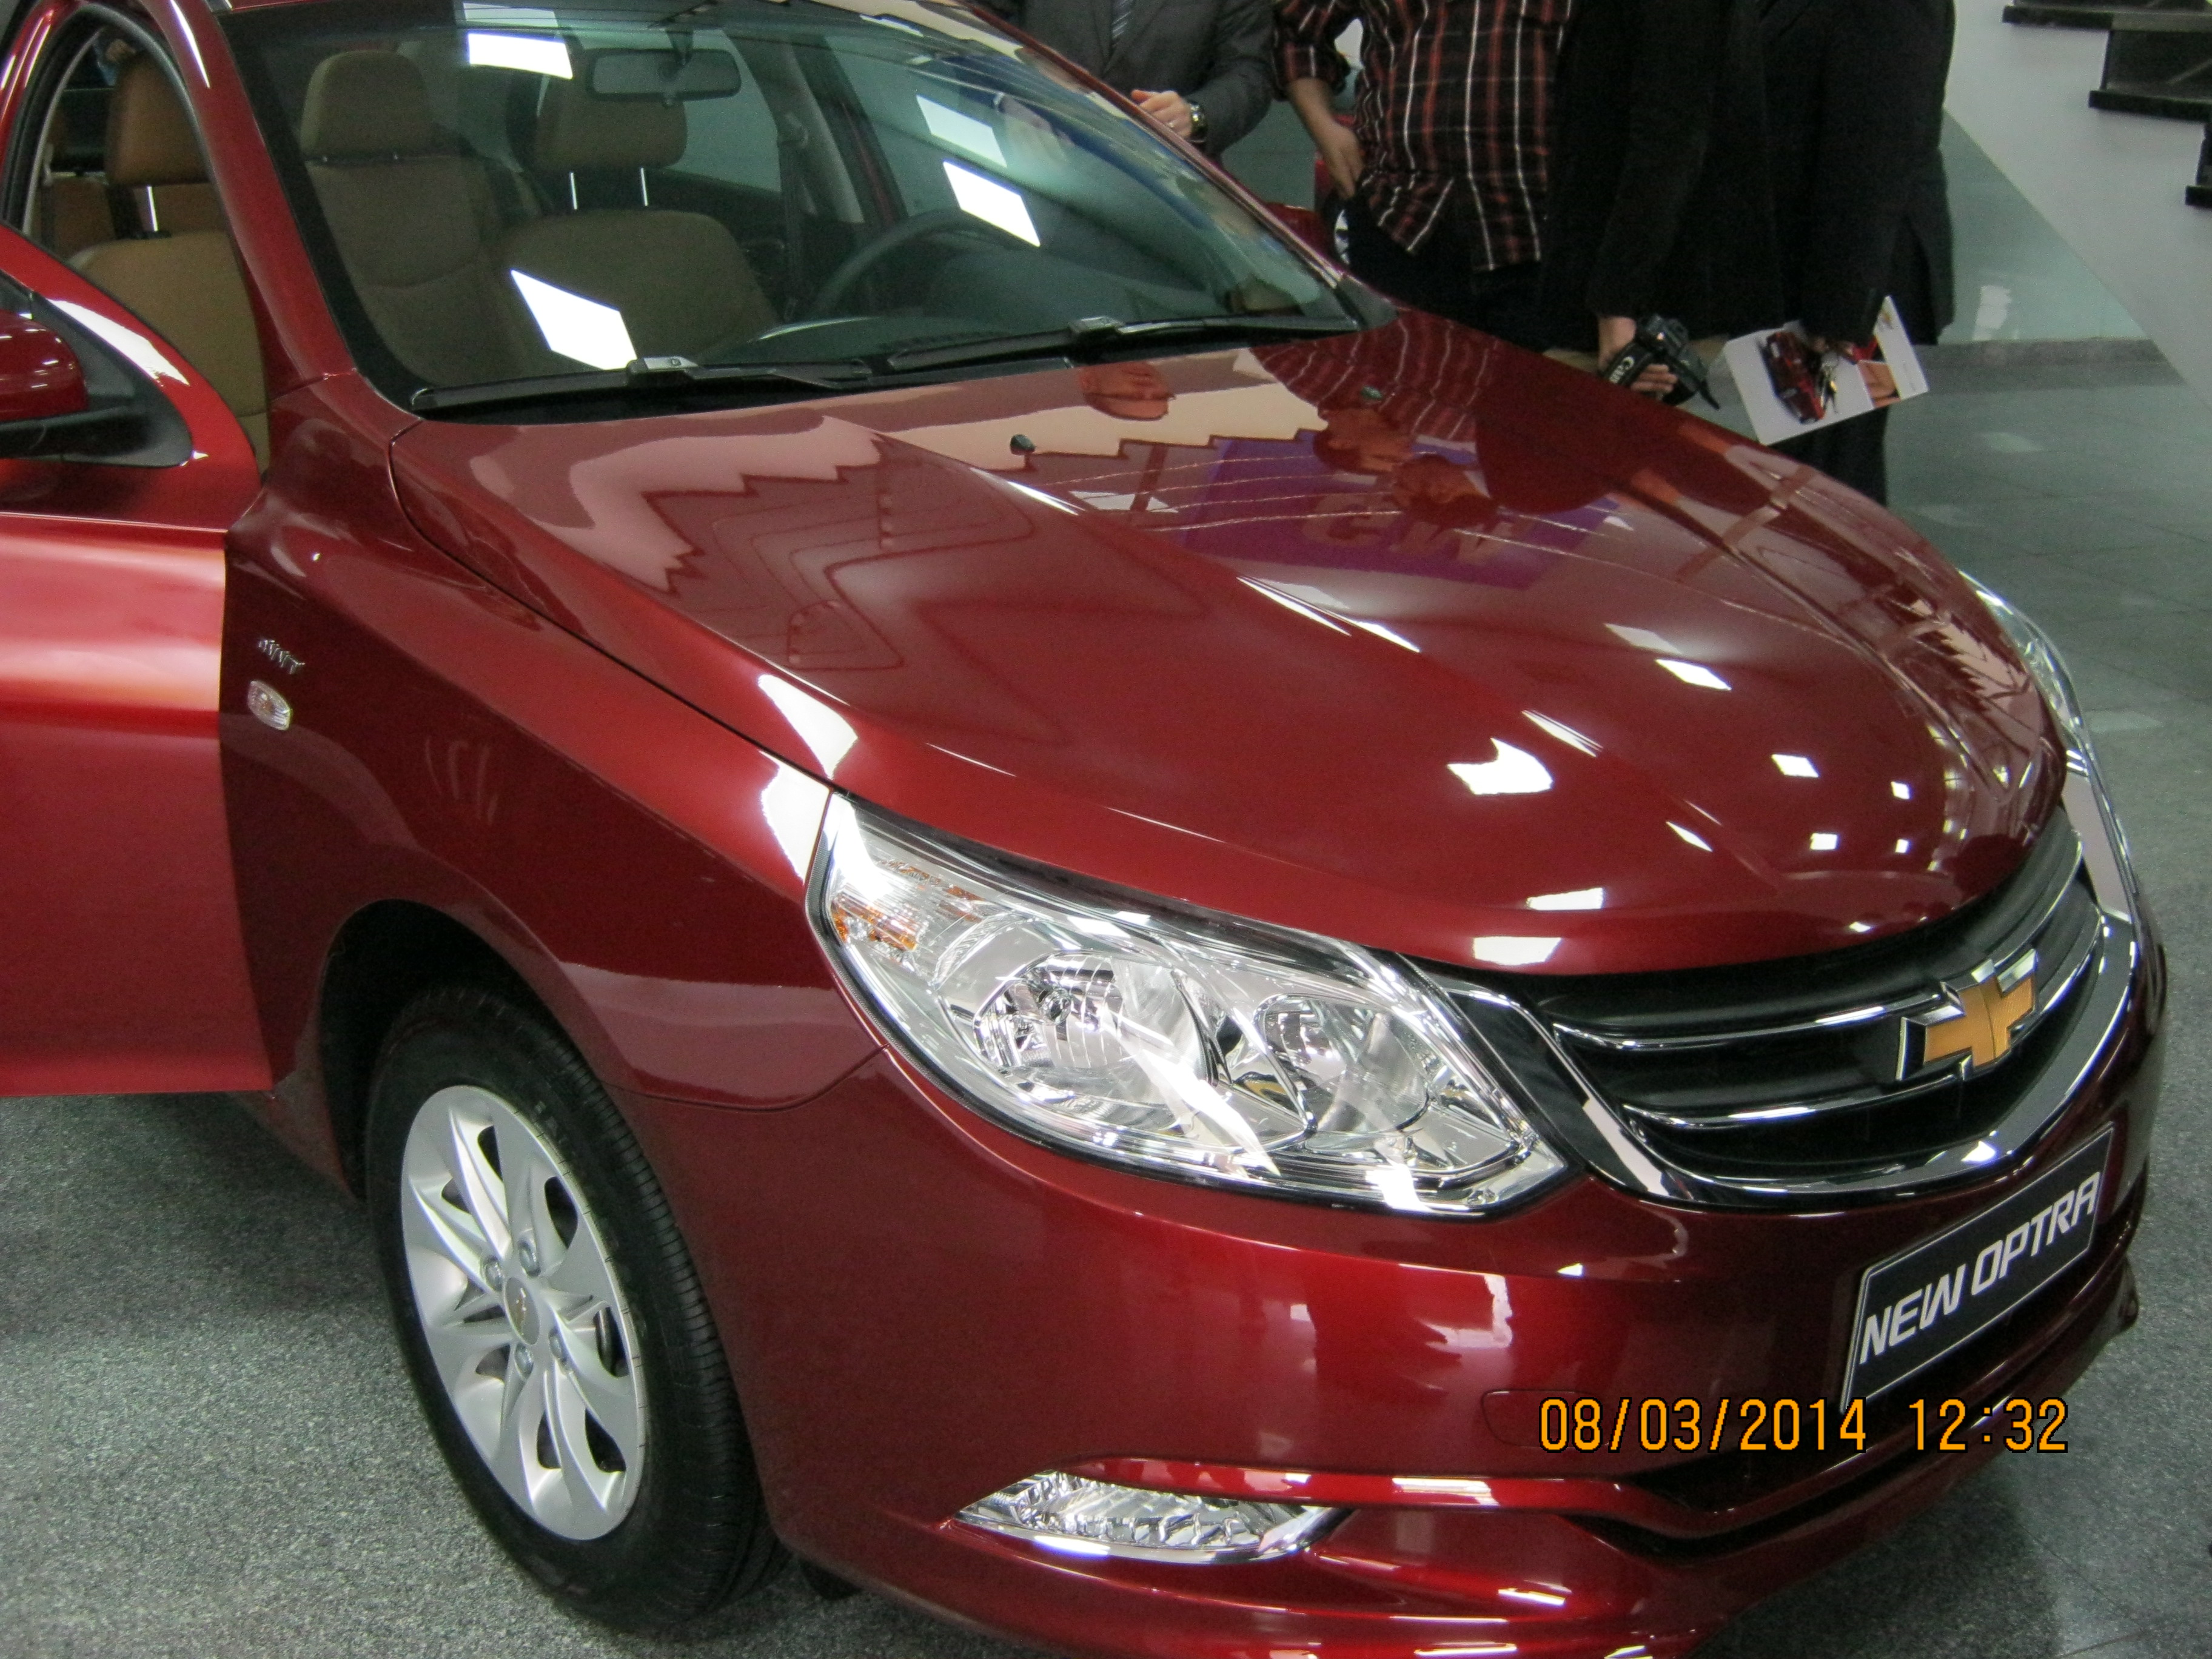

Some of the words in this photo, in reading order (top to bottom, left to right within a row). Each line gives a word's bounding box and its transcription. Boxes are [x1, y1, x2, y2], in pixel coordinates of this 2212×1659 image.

[1609, 356, 1635, 384] Can
[1859, 1263, 1966, 1365] NEW
[1971, 1171, 2101, 1296] OPTRA
